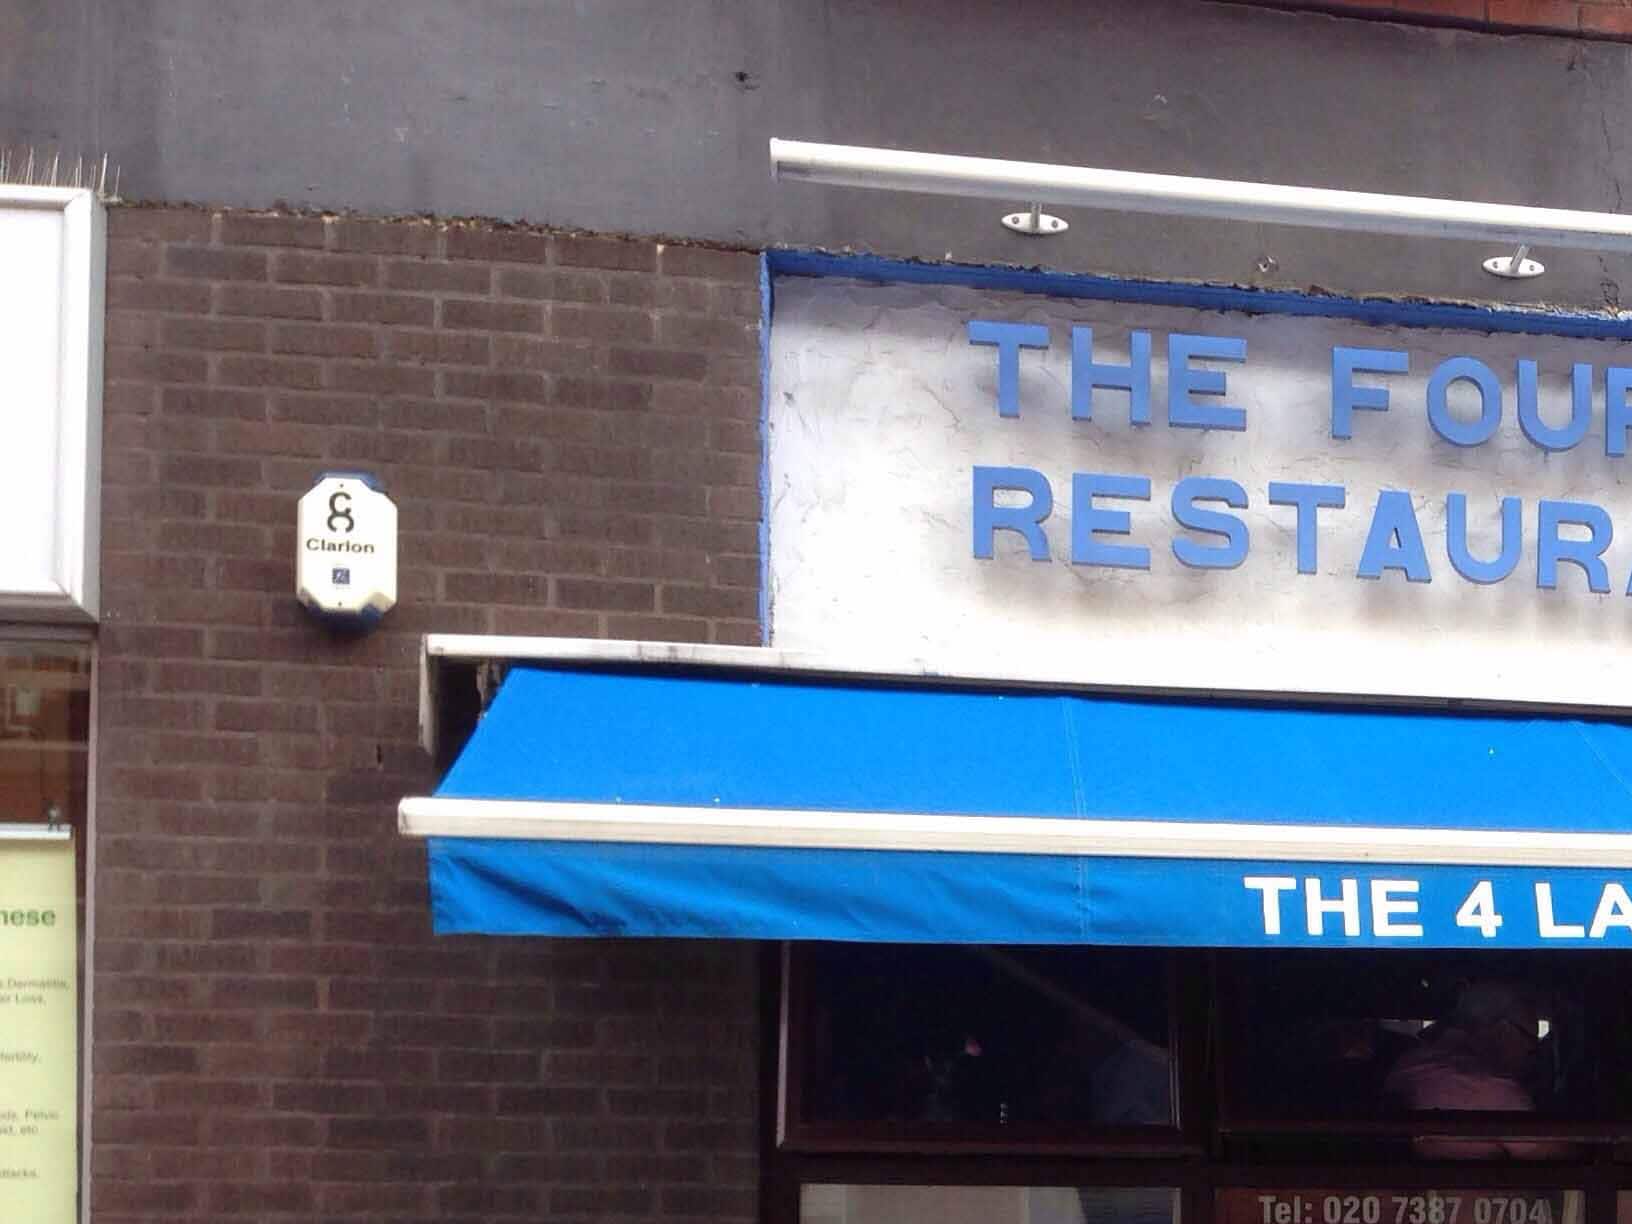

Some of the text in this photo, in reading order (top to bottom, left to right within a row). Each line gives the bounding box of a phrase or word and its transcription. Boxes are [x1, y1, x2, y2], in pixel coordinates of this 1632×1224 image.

[969, 319, 1248, 432] THE
[306, 537, 375, 554] Clarion
[1243, 876, 1423, 937] THE
[1455, 880, 1504, 938] 4
[1258, 1195, 1313, 1224] Tel:
[1323, 1195, 1381, 1224] 020
